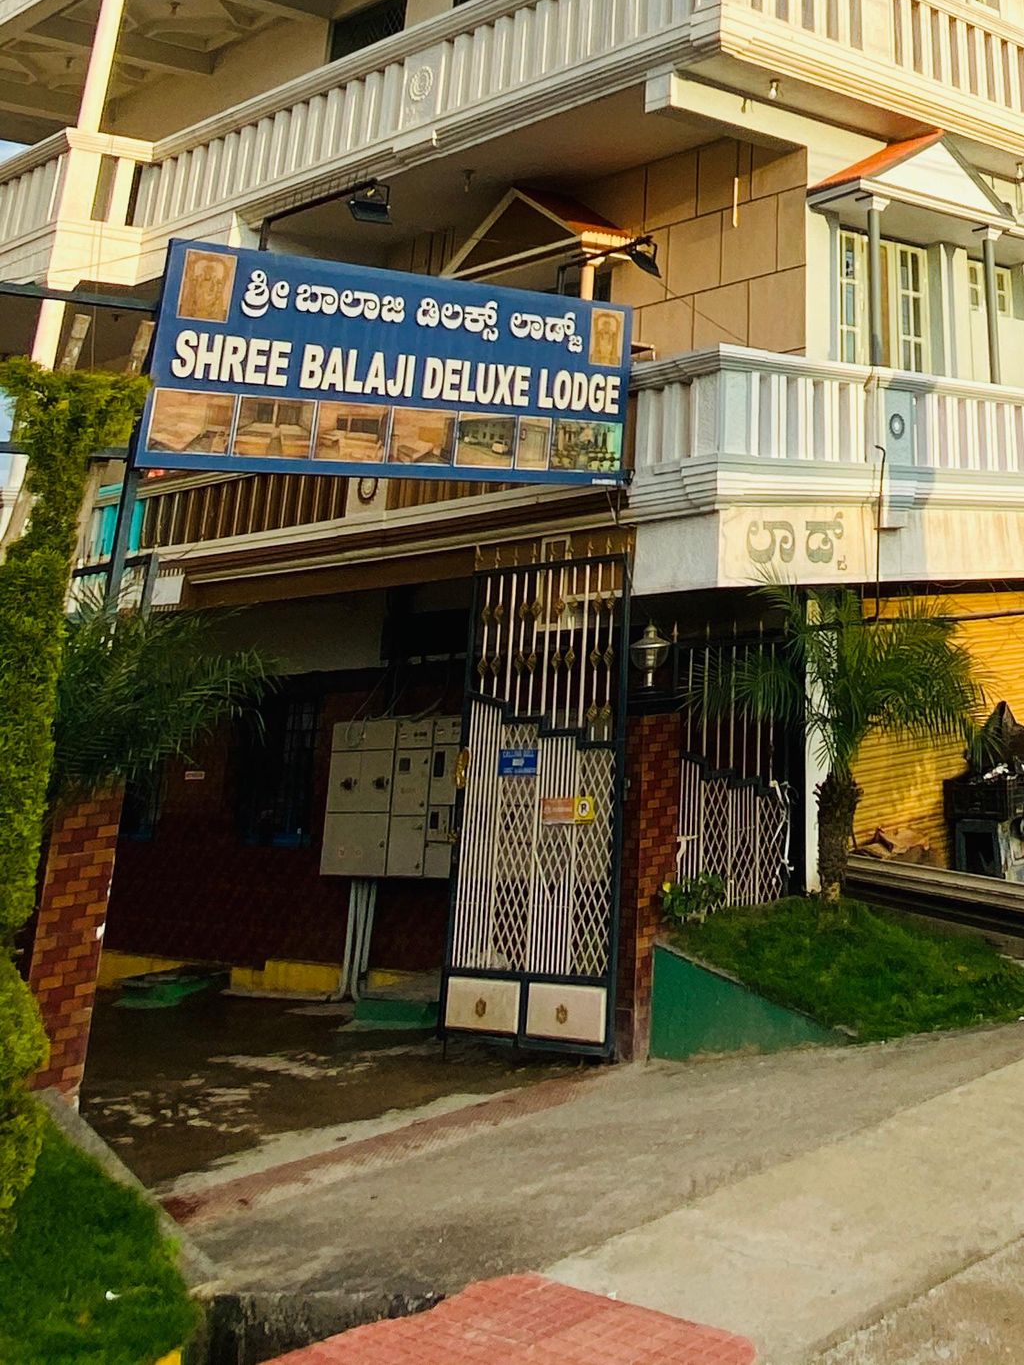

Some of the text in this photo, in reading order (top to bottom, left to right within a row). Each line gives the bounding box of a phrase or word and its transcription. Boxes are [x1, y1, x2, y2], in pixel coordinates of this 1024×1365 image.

[241, 269, 584, 353] ಶ್ರೀ ಬಾಲಾಜಿ ಡಿಲಕ್ಸ್ ಲಾಡ್ಜ್
[171, 329, 621, 414] SHREE BALAJI DELUXE LODGE
